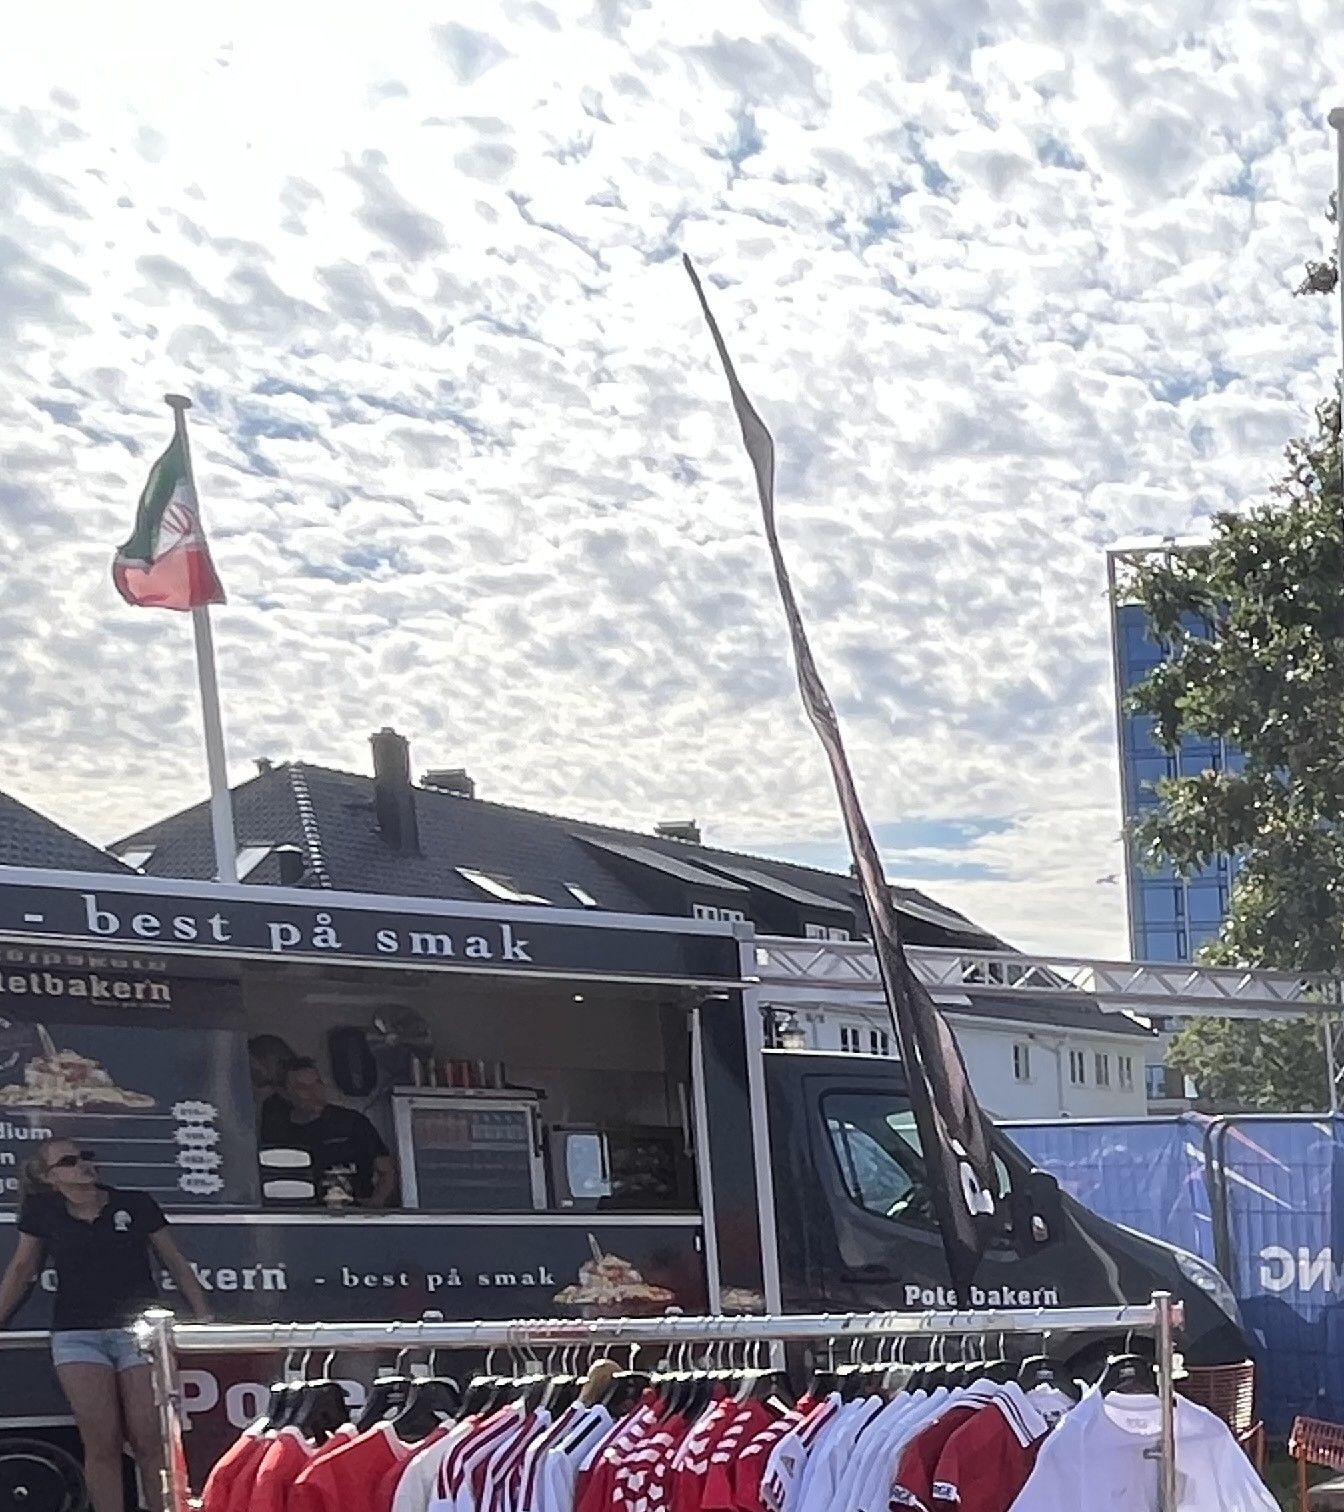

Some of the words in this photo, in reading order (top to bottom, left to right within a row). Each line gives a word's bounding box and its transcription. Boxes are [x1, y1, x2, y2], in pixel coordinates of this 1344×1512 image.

[81, 894, 232, 942] best
[266, 912, 343, 951] på
[376, 923, 533, 962] smak
[341, 1266, 410, 1288] best
[426, 1268, 462, 1292] på
[478, 1266, 556, 1287] smak
